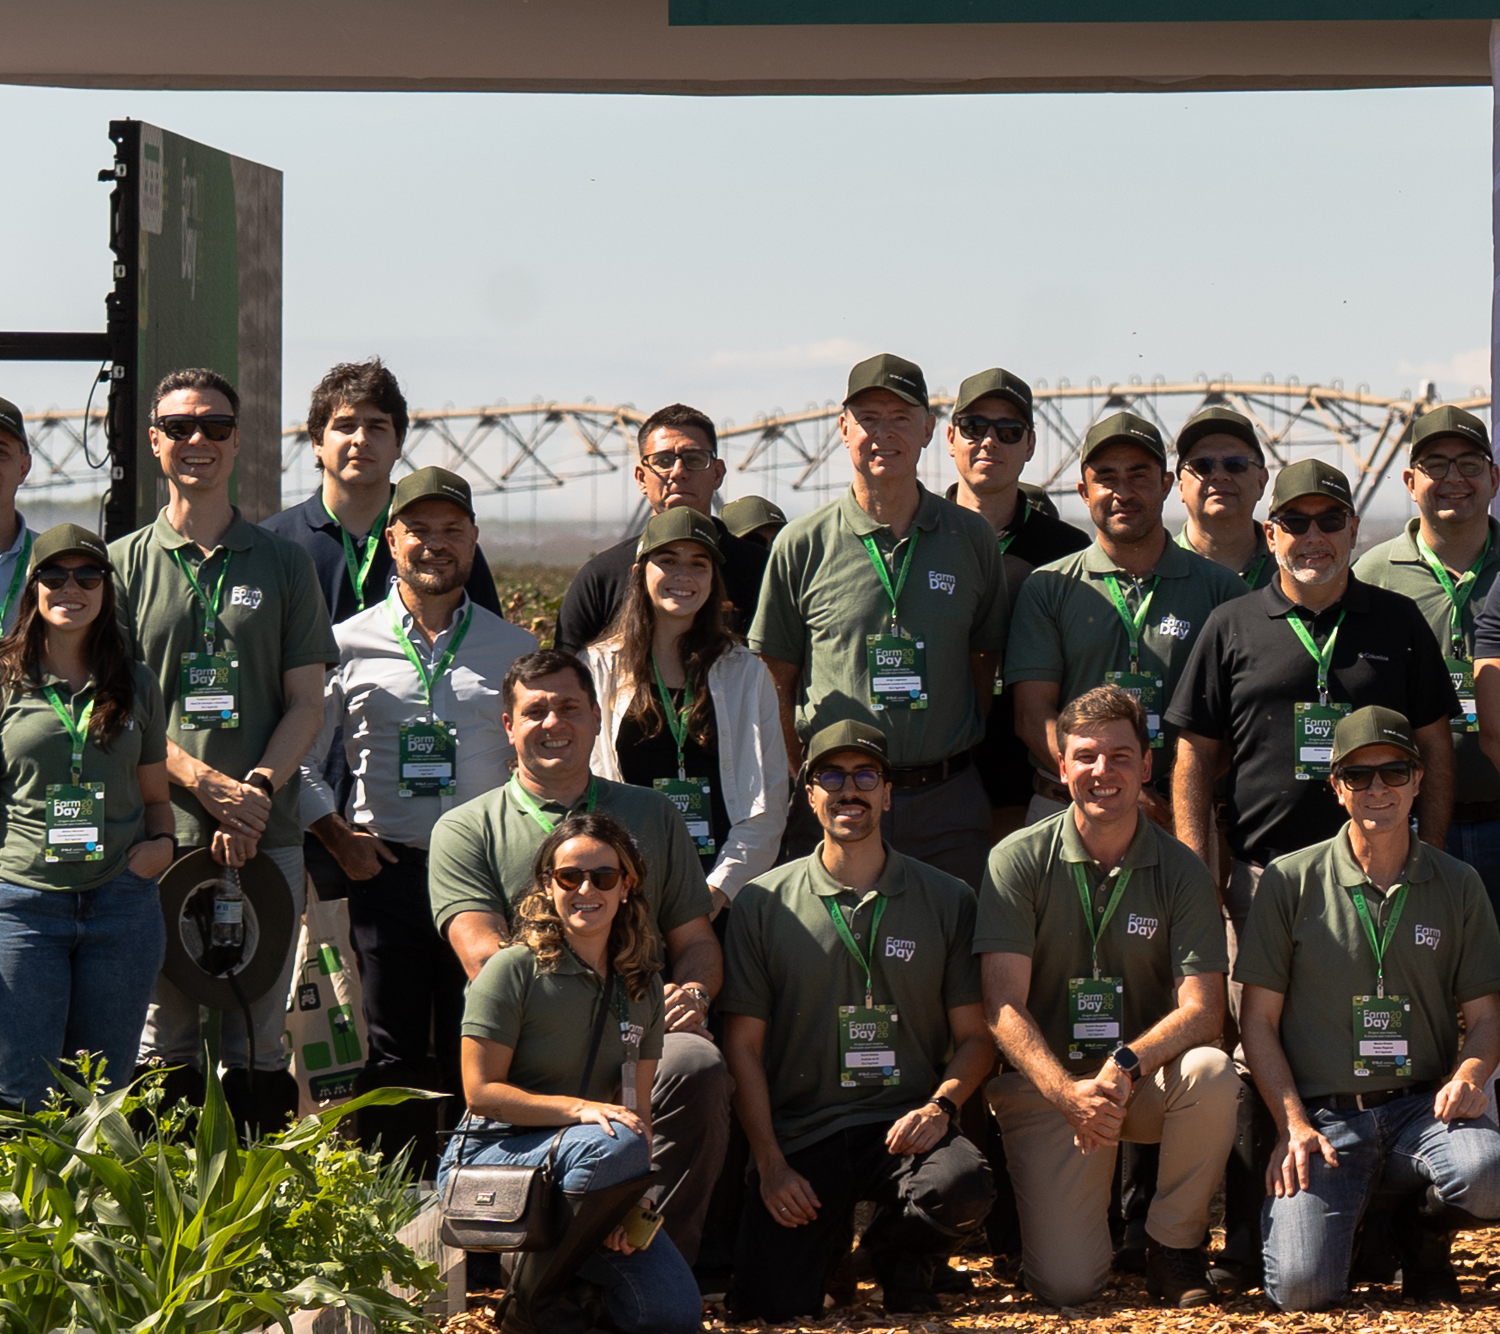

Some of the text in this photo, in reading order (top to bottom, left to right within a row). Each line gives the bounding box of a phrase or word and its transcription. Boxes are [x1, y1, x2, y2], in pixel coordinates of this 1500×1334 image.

[929, 571, 955, 583] Farm
[232, 587, 262, 598] Farm
[930, 581, 955, 594] Day
[231, 595, 261, 609] Day
[1162, 617, 1190, 629] Farm
[1160, 625, 1188, 639] Day
[876, 655, 901, 666] Day
[190, 668, 216, 676] Farm
[190, 675, 215, 686] Day
[1305, 718, 1330, 726] Farm
[1305, 725, 1330, 737] Day
[408, 735, 433, 743] Farm
[408, 741, 432, 753] Day
[54, 807, 80, 818] Day
[1129, 914, 1158, 926] Farm
[1128, 922, 1157, 939] Day
[1415, 925, 1440, 937] Farm
[886, 937, 915, 949] Farm
[1415, 933, 1439, 950] Day
[886, 945, 914, 961] Day
[1078, 993, 1102, 1001] Farm
[1078, 1000, 1101, 1011] Day
[1364, 1010, 1389, 1018] Farm
[850, 1022, 876, 1030] Farm
[1364, 1018, 1389, 1030] Day
[850, 1029, 875, 1041] Day
